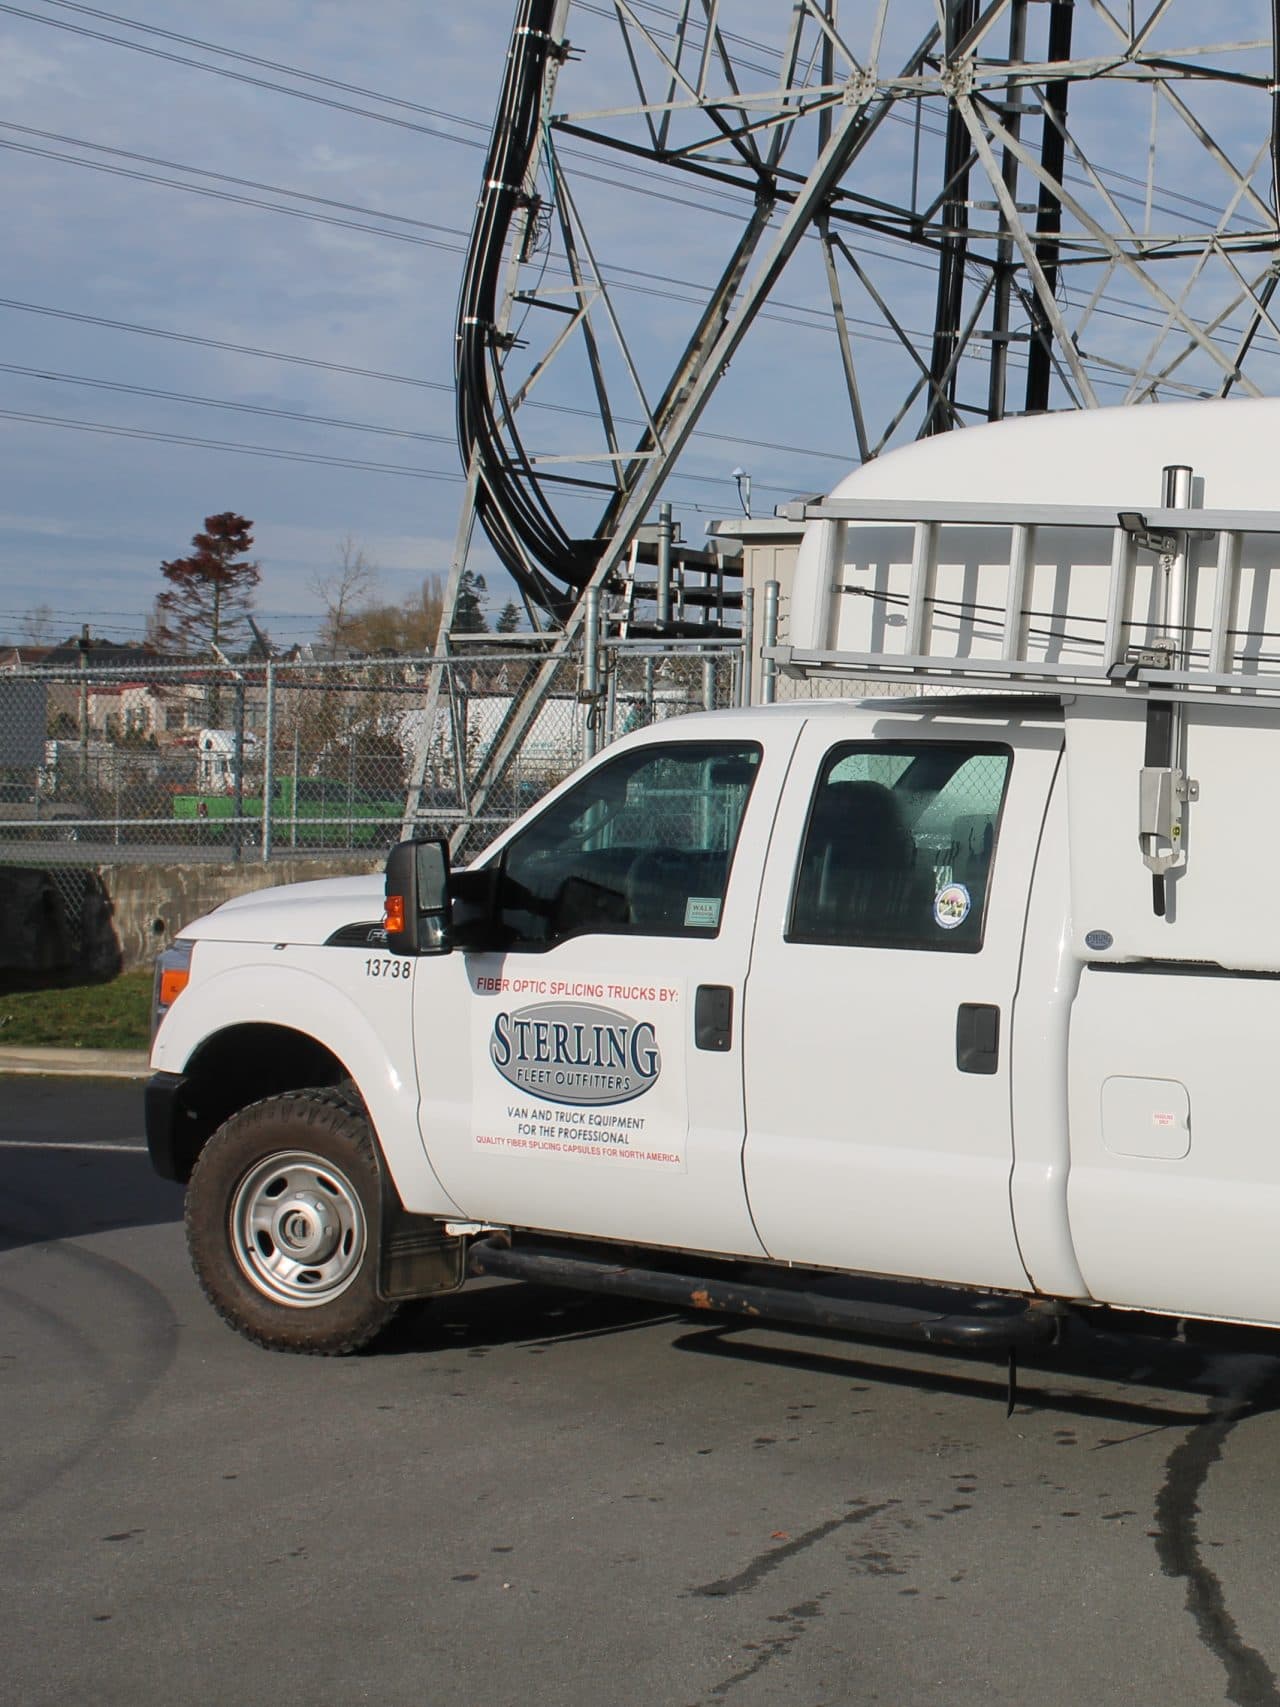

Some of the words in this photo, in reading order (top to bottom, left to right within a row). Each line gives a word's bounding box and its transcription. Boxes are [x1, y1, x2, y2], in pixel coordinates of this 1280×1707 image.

[365, 958, 412, 979] 13738
[476, 977, 510, 992] FIBER
[513, 980, 547, 994] OPTIC
[550, 982, 604, 997] SPLICING
[607, 985, 656, 1000] TRUCKS
[659, 989, 679, 1002] BY:
[494, 1012, 658, 1078] STERLING
[517, 1068, 551, 1083] FLEET
[555, 1071, 631, 1090] OUTFITTERS
[507, 1106, 528, 1119] VAN
[531, 1109, 552, 1121] AND
[555, 1111, 586, 1125] TRUCK
[588, 1113, 646, 1130] EQUIPMENT
[518, 1123, 537, 1136] FOR
[539, 1125, 556, 1138] THE
[558, 1127, 630, 1145] PROFESSIONAL
[475, 1135, 506, 1145] QUALITY
[506, 1138, 527, 1148] FIBER
[529, 1140, 561, 1152] SPLICING
[562, 1144, 602, 1156] CAPSULES
[603, 1147, 618, 1157] FOR
[620, 1149, 645, 1160] NORTH
[646, 1152, 681, 1163] AMERICA
